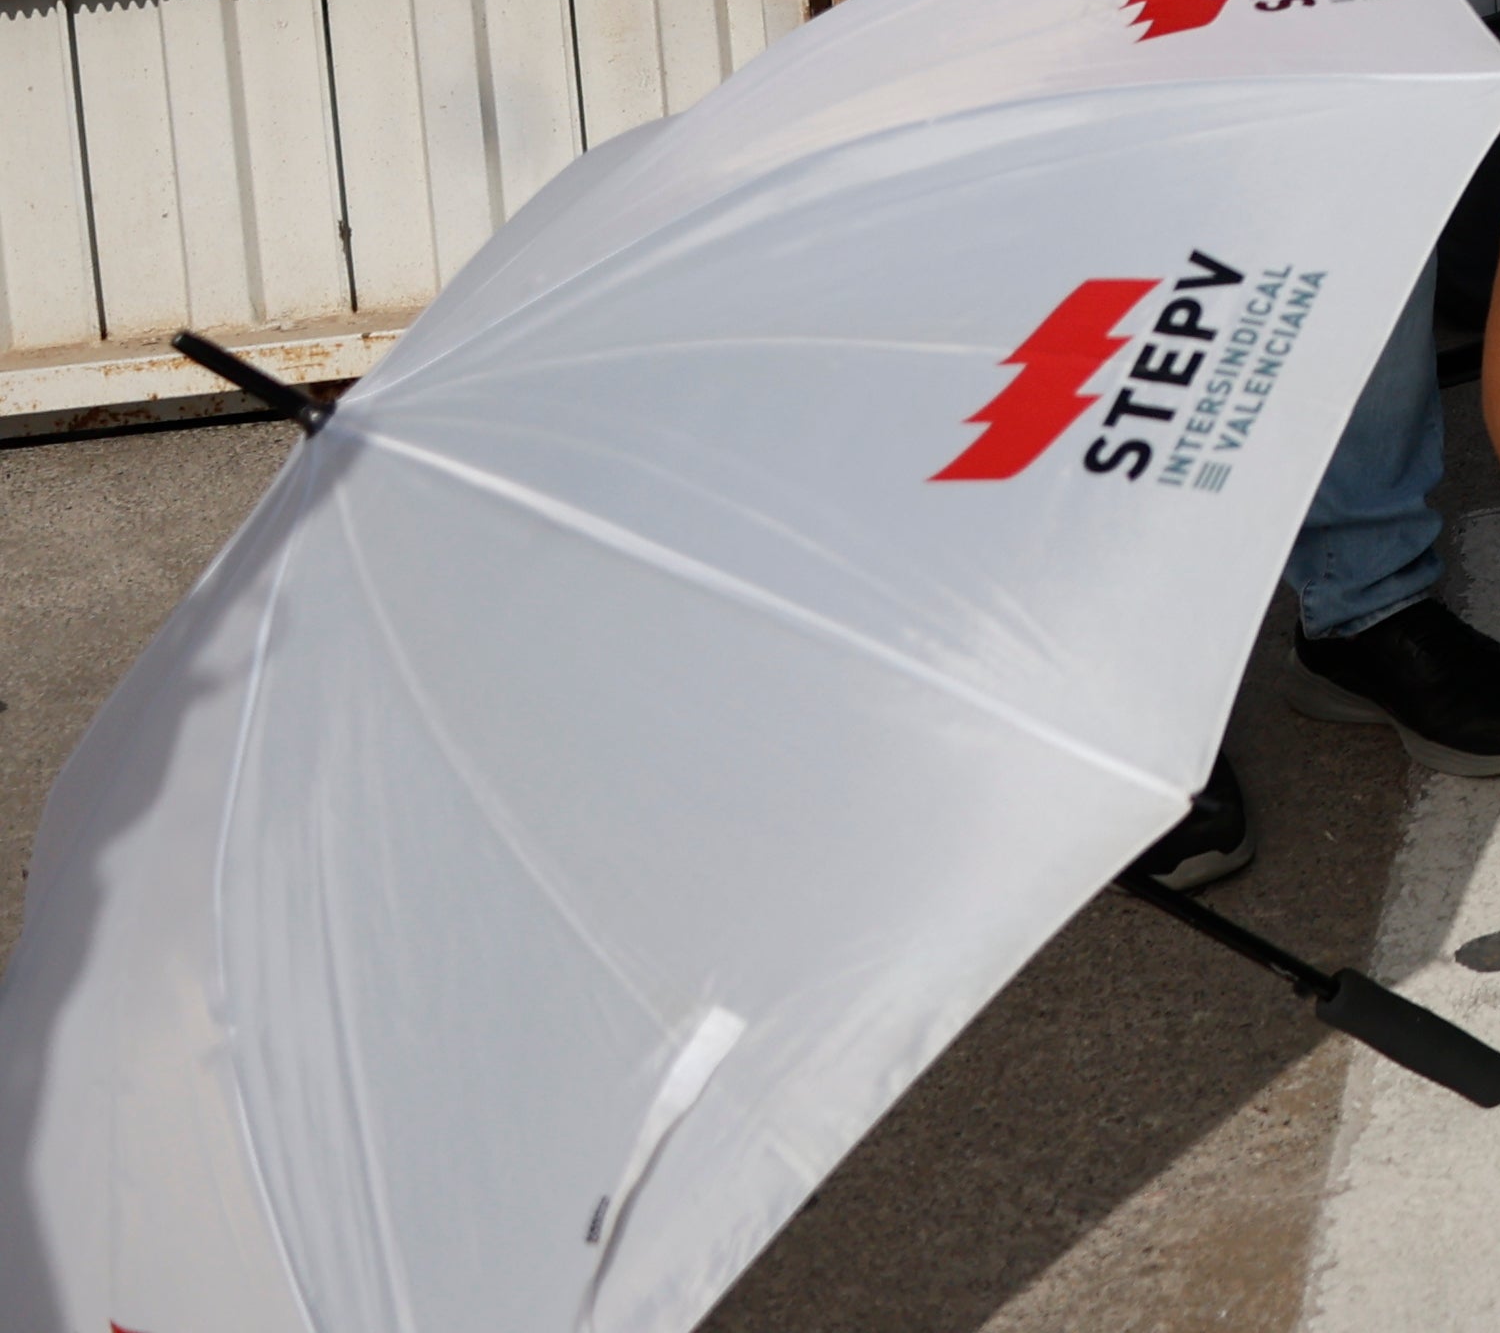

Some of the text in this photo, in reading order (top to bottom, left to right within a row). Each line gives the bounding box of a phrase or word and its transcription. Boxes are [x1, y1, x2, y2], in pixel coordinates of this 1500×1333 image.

[1083, 249, 1246, 482] STEPV
[1157, 263, 1293, 486] INTERSINDICAL
[1214, 271, 1329, 450] VALENCIANA
